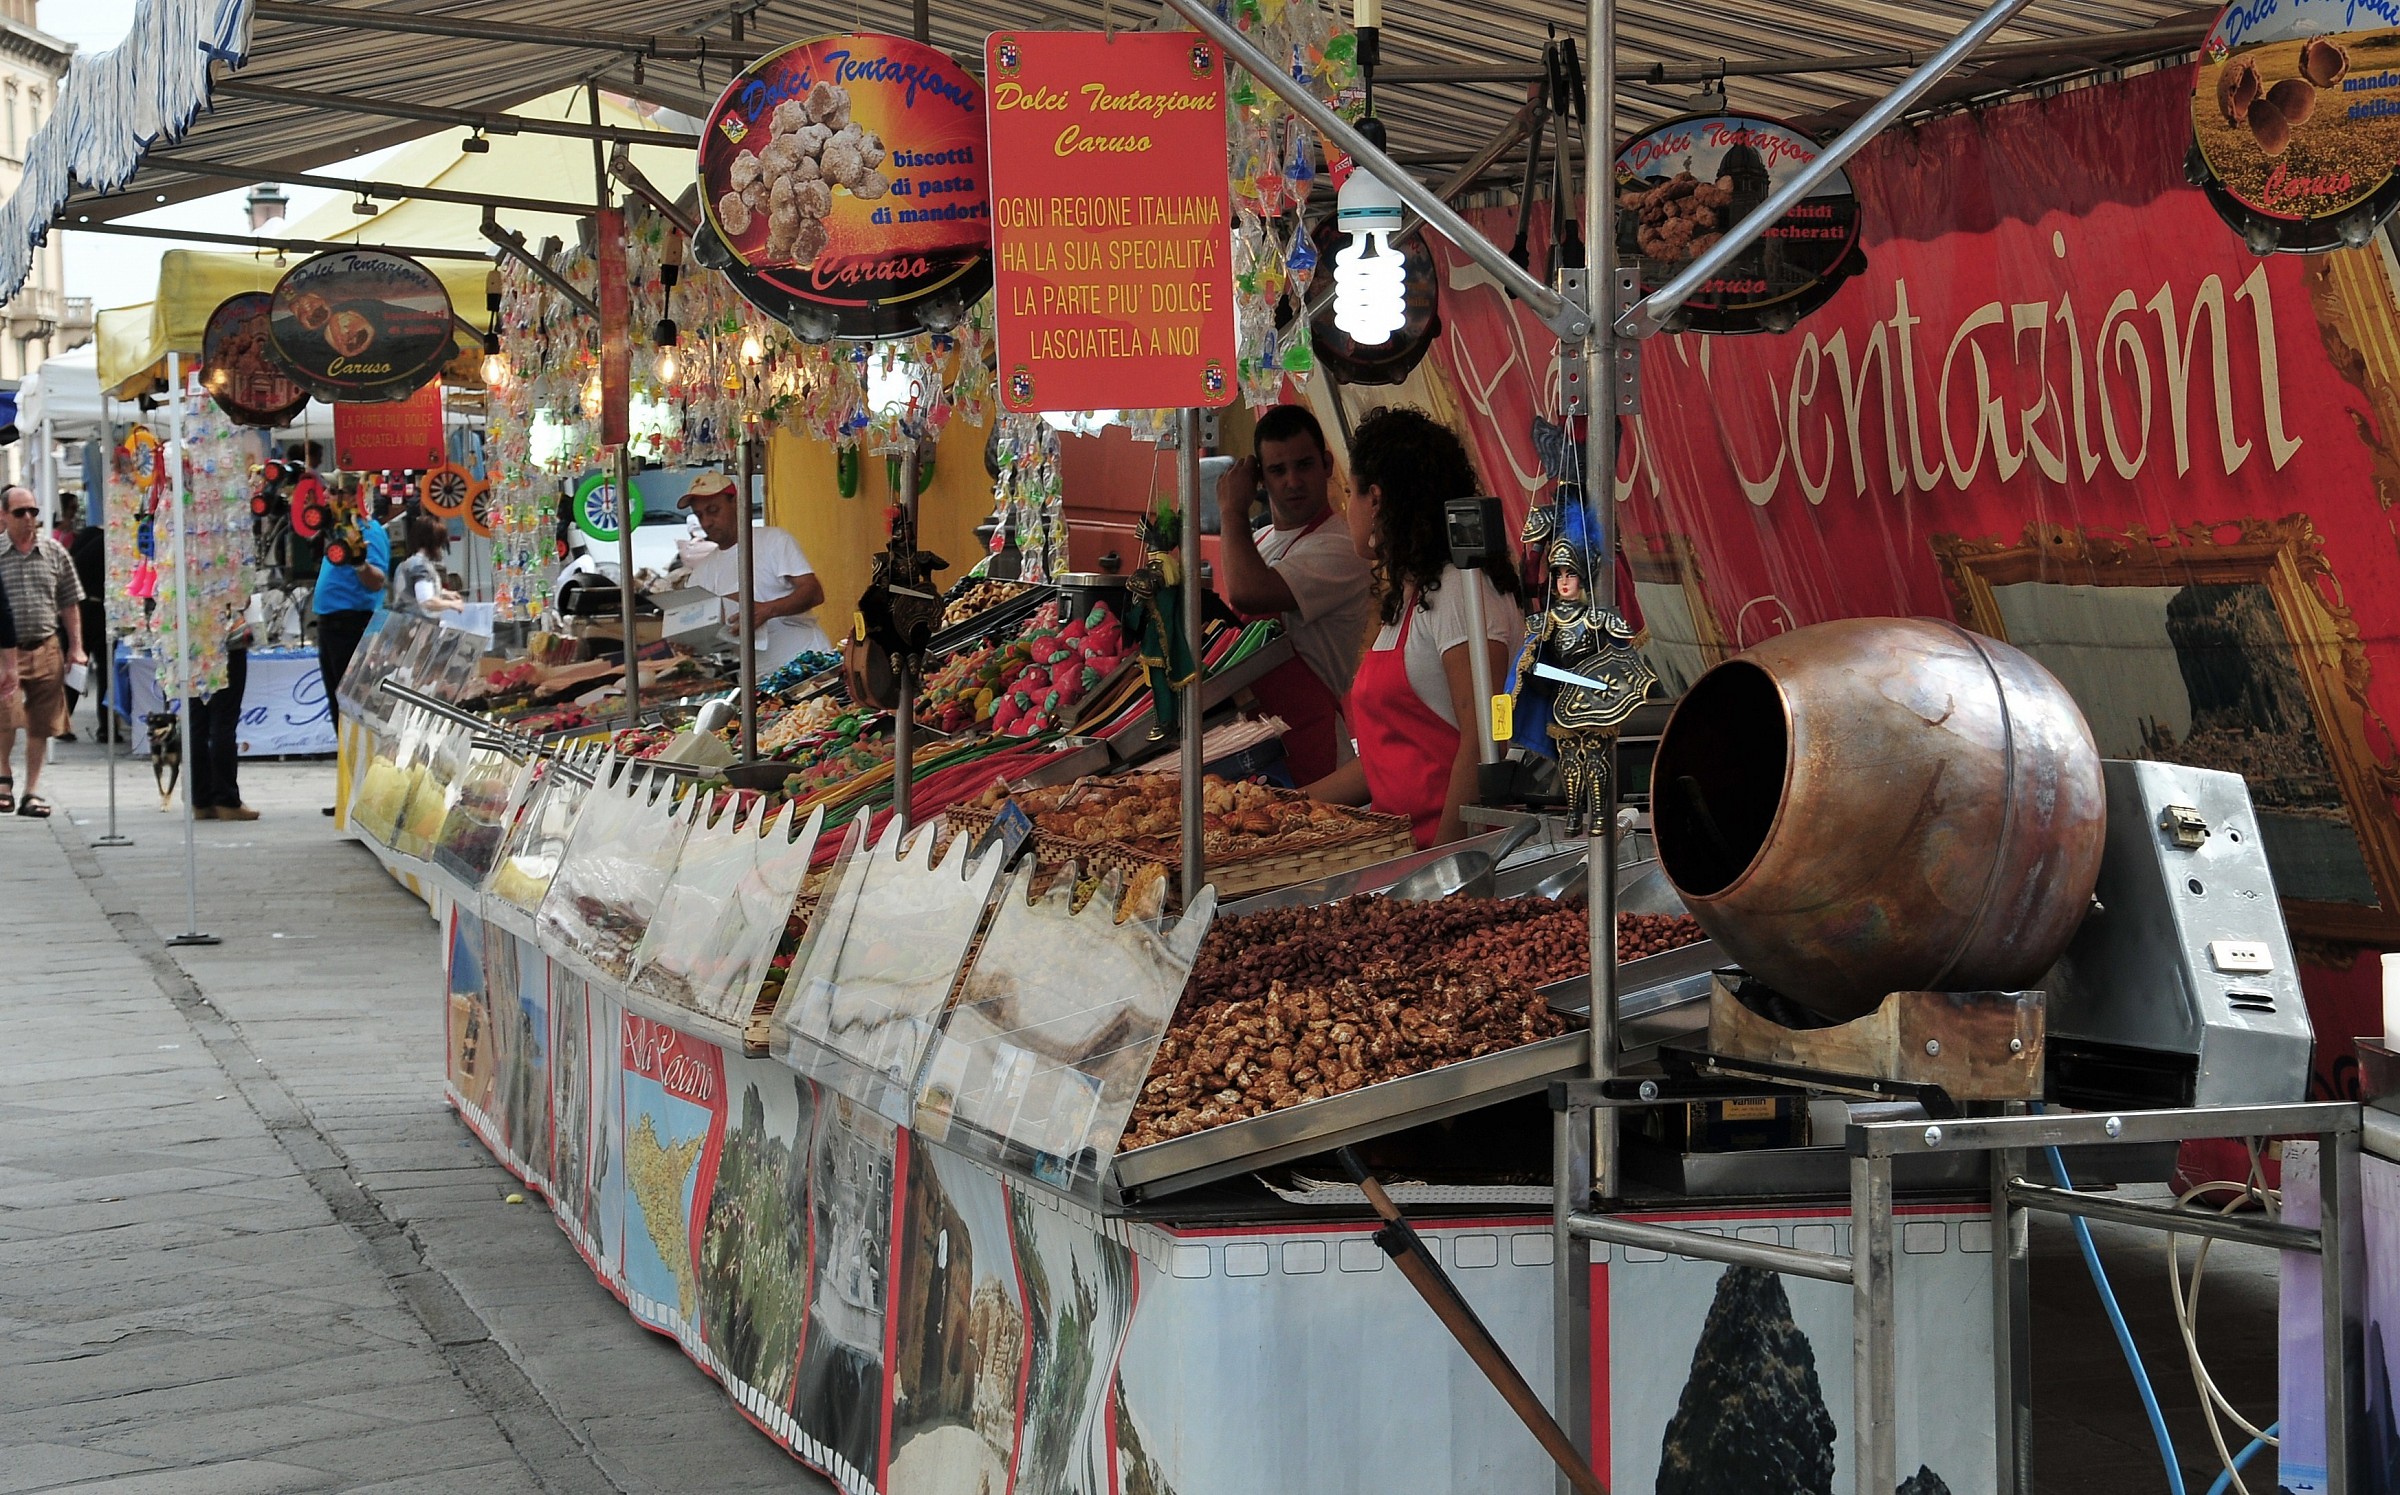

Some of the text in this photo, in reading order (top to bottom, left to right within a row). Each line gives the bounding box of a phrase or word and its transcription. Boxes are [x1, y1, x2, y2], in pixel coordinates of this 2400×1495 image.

[741, 50, 975, 121] Dolci Tentazioni
[2342, 71, 2400, 92] mando
[995, 82, 1217, 119] Dolci Tentazioni
[2348, 99, 2400, 119] sicilia
[1054, 124, 1152, 157] Caruso
[1631, 123, 1816, 170] Dolci Tentazion
[892, 147, 974, 168] biscotti
[890, 177, 975, 197] di pasta
[2263, 163, 2352, 205] Caruso
[871, 201, 991, 225] di mandorl
[998, 196, 1221, 228] OGNI REGIONE ITALIANA
[293, 255, 429, 288] Dolci Tentazioni
[1001, 242, 1028, 272] HA
[1034, 241, 1058, 271] LA
[1064, 241, 1103, 271] SUA
[812, 255, 929, 291] Caruso
[1698, 279, 1767, 294] aruso
[1013, 286, 1037, 316] LA
[1043, 285, 1101, 315] PARTE
[1152, 283, 1213, 312] DOLCE
[1030, 326, 1200, 360] LASCIATELA A NOI
[327, 356, 392, 377] Caruso
[355, 413, 382, 428] PARTE
[405, 413, 433, 427] DOLCE
